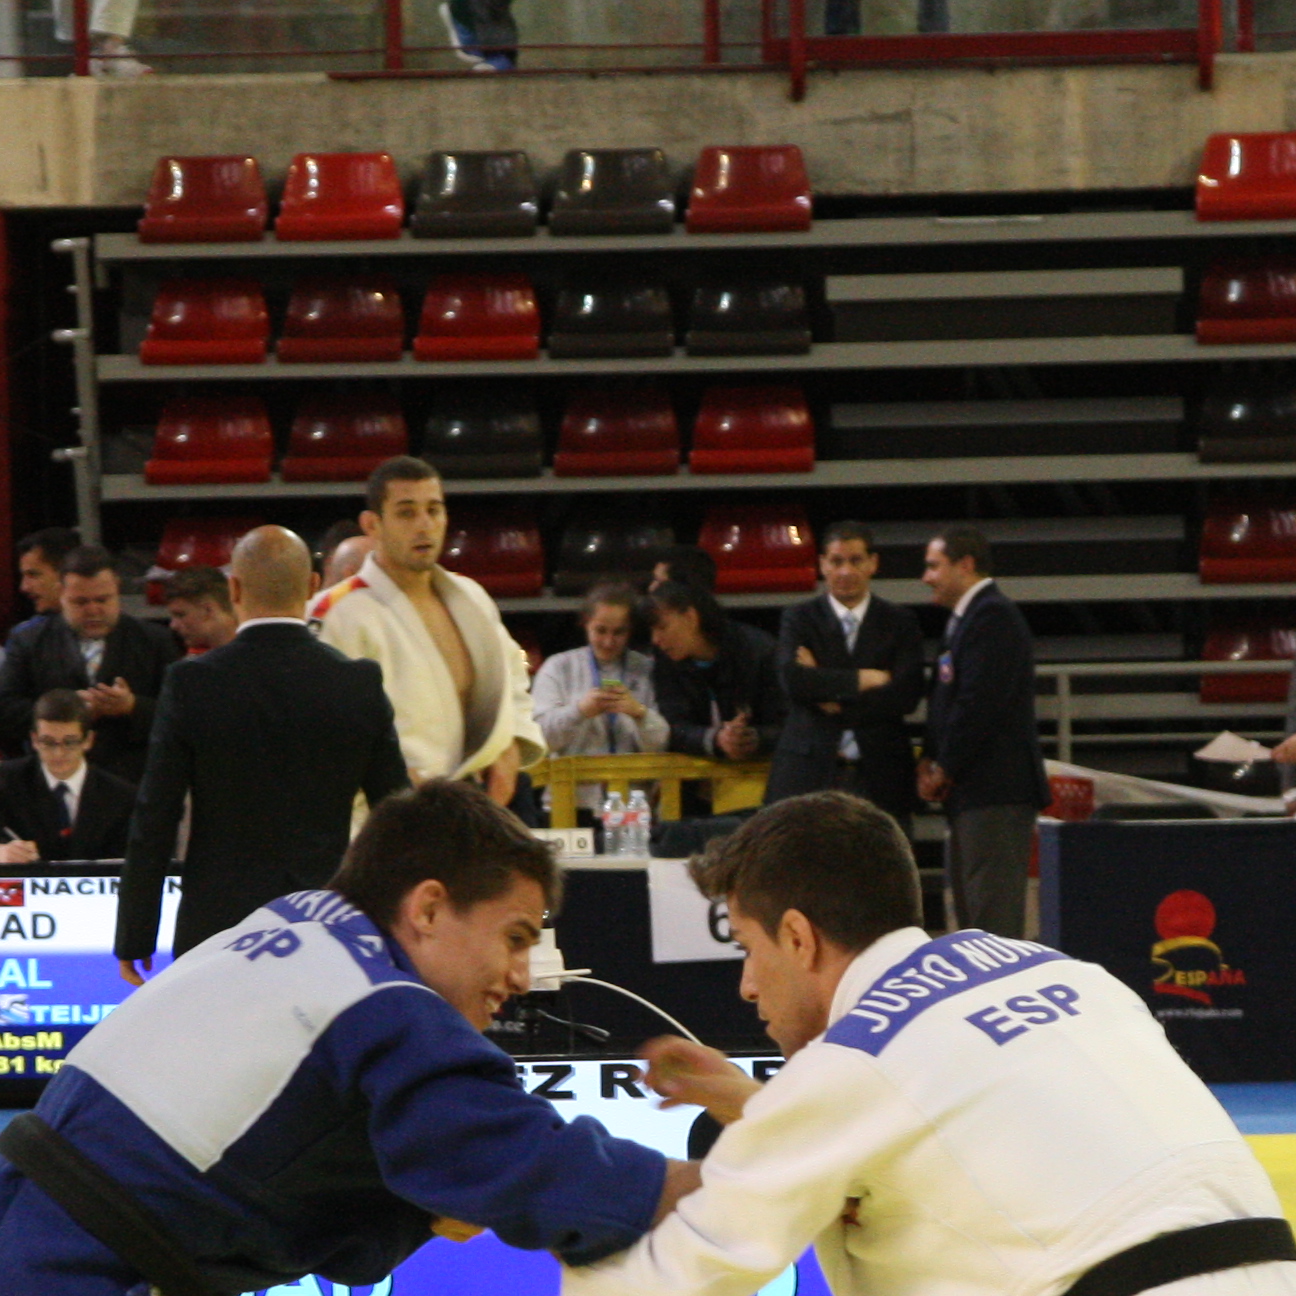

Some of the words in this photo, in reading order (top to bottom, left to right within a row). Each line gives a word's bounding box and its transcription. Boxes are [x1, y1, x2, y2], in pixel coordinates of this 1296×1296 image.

[850, 952, 968, 1034] JUSTO
[1174, 963, 1247, 987] ESPAÑA
[964, 983, 1082, 1046] ESP
